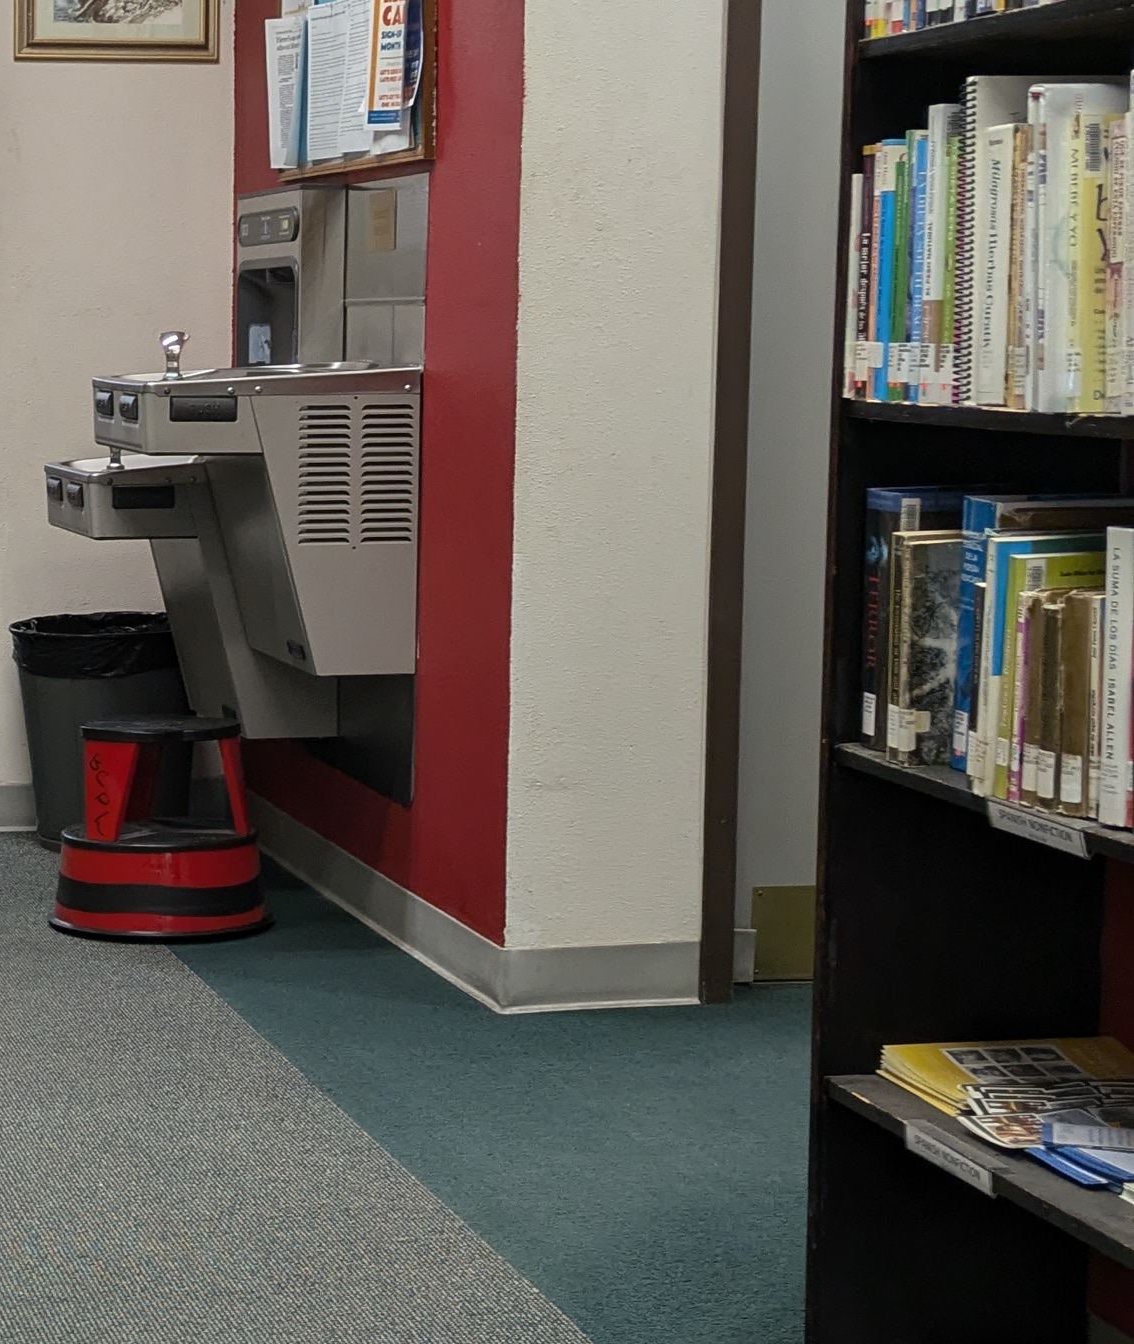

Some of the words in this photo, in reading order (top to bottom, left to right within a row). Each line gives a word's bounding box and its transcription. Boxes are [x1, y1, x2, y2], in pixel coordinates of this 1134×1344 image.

[1070, 147, 1080, 166] MI
[989, 159, 1002, 231] Milagrosas
[915, 193, 926, 236] DIETA
[1069, 224, 1078, 248] YO
[986, 233, 999, 292] Hierbas
[911, 291, 924, 341] BEACH
[1112, 547, 1121, 561] LA
[1110, 565, 1120, 597] SUMA
[866, 575, 881, 669] TERROR
[1109, 600, 1119, 616] DE
[1109, 620, 1118, 641] LOS
[1108, 645, 1121, 670] DÍAS
[1106, 678, 1117, 719] ISABEL
